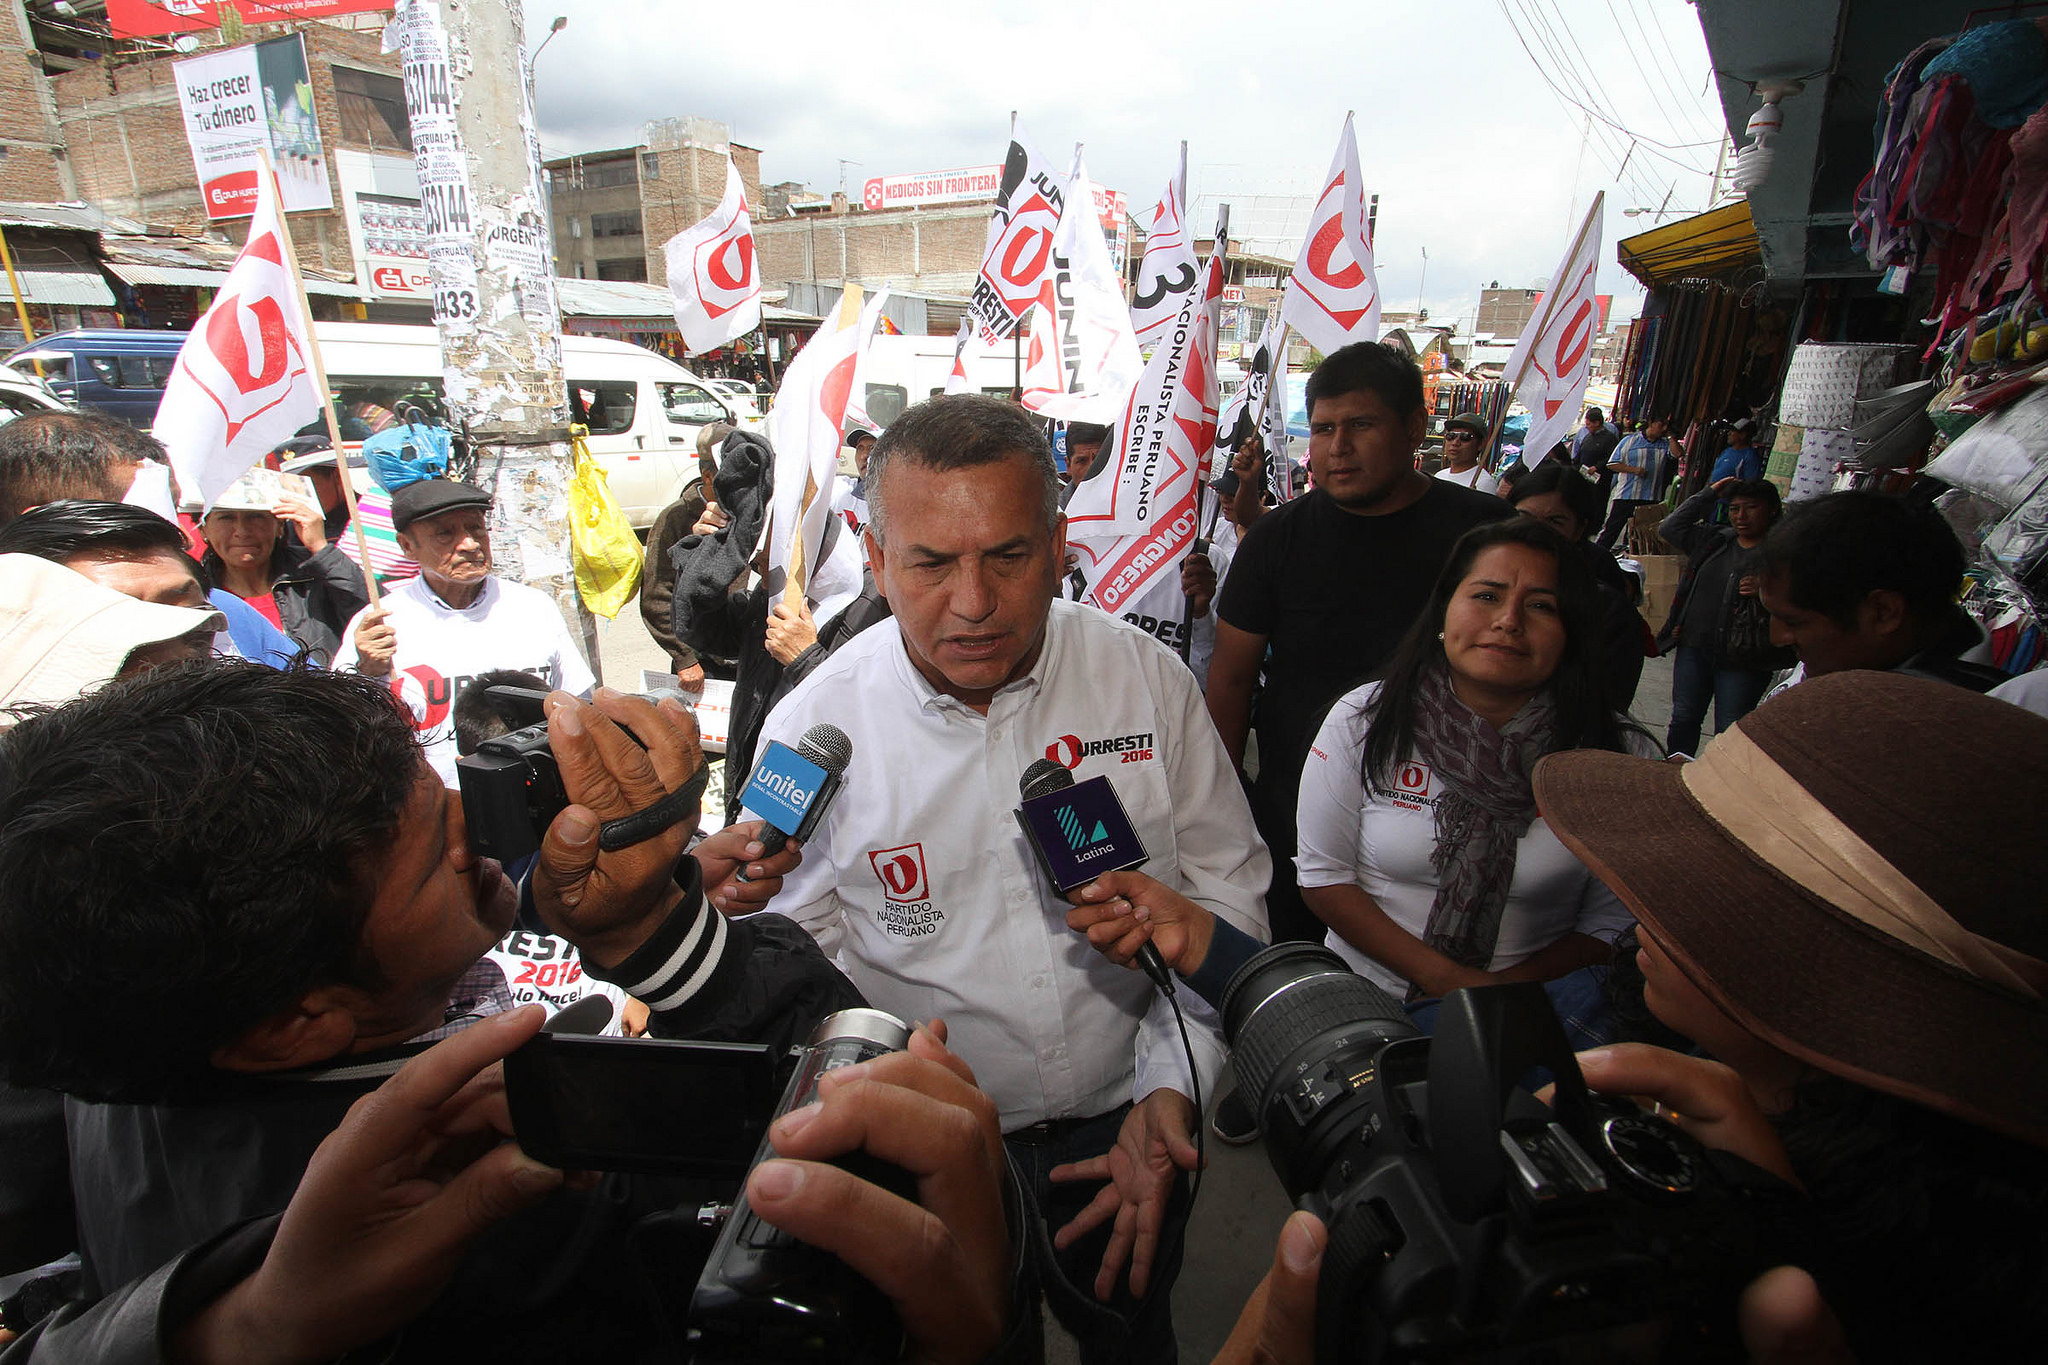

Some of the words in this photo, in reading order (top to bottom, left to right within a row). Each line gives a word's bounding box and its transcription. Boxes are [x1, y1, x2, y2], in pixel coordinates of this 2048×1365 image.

[187, 85, 209, 105] Haz
[210, 73, 252, 101] crecer
[194, 112, 212, 133] Tu
[212, 102, 257, 130] dinero
[885, 181, 925, 200] MEDICOS
[926, 178, 944, 196] SIN
[945, 173, 998, 194] FRONTERA
[491, 225, 538, 248] URGENT
[1125, 403, 1150, 475] ESCRIBE
[1136, 430, 1165, 522] PERUANO
[1077, 732, 1154, 758] URRESTI
[1120, 749, 1154, 764] 2016
[756, 765, 816, 811] unitel
[1373, 788, 1399, 800] PARTIDO
[1400, 792, 1442, 807] NACIONALIST
[1392, 799, 1423, 812] PERUANO
[1075, 843, 1116, 864] Latina
[877, 910, 945, 926] NACIONALISTA
[885, 902, 932, 915] PARTIDO
[887, 923, 936, 937] PERUANO
[513, 960, 582, 988] 2016
[1335, 1037, 1349, 1048] 24
[1296, 1061, 1309, 1075] 35
